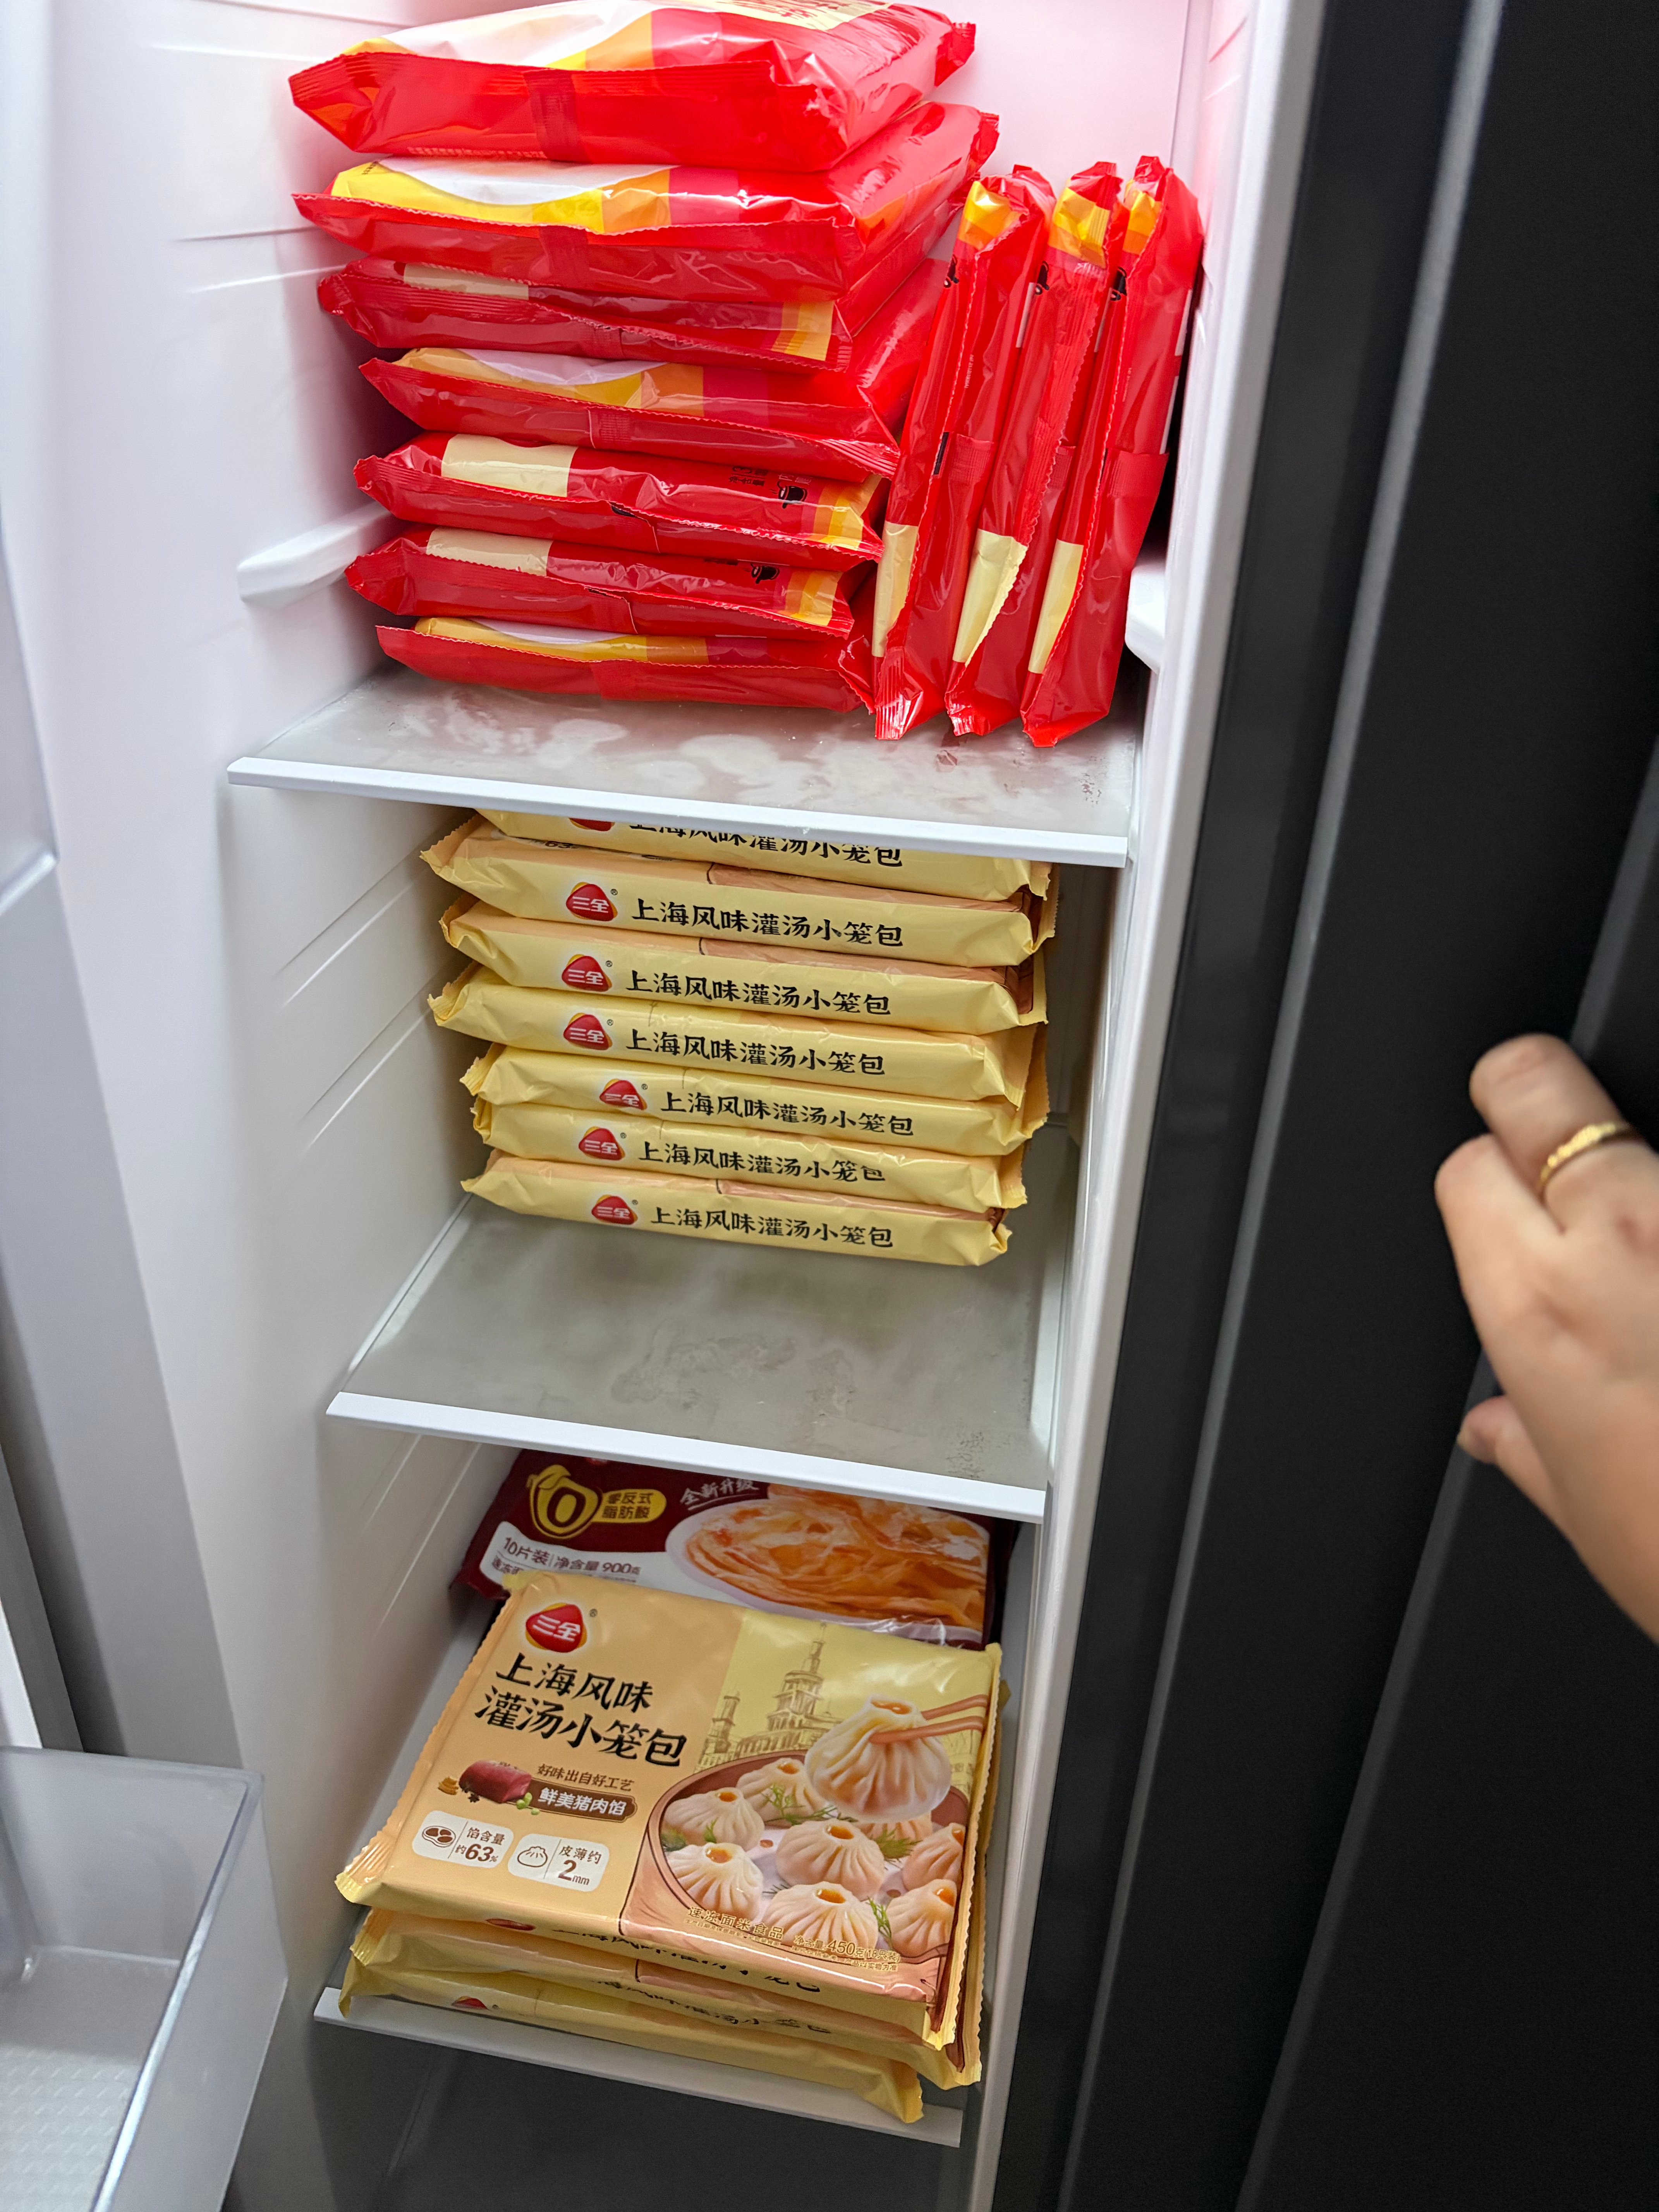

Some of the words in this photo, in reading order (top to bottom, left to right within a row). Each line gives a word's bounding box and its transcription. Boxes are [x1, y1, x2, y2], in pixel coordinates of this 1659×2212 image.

[572, 896, 609, 914] 三全
[632, 898, 903, 947] 上海风味灌汤小笼包
[568, 968, 604, 986] 三全
[626, 969, 891, 1015] 上海风味灌汤小笼包
[570, 1026, 605, 1044] 三全
[627, 1029, 885, 1075] 上海风味灌汤小笼包
[605, 1093, 639, 1107] 三全
[661, 1091, 914, 1136] 上海风味灌汤小笼包
[584, 1139, 618, 1155] 三全
[639, 1141, 886, 1182] 上海风味灌汤小笼包
[596, 1206, 630, 1219] 三全
[651, 1207, 893, 1248] 上海风味灌汤小笼包
[680, 1477, 759, 1505] 全新升级
[503, 1537, 550, 1566] 10片装
[554, 1555, 600, 1571] 净含量
[532, 1614, 581, 1642] 三全
[496, 1652, 654, 1713] 上海风味
[474, 1685, 687, 1767] 灌汤小笼包
[538, 1763, 635, 1792] 好味出自好工艺
[537, 1787, 627, 1816] 鲜美猪肉馅
[466, 1826, 505, 1845] 馅含量
[455, 1843, 499, 1863] 约63%
[559, 1845, 602, 1865] 皮薄约
[558, 1859, 590, 1886] 2mm
[688, 1906, 785, 1940] 速冻面米食品
